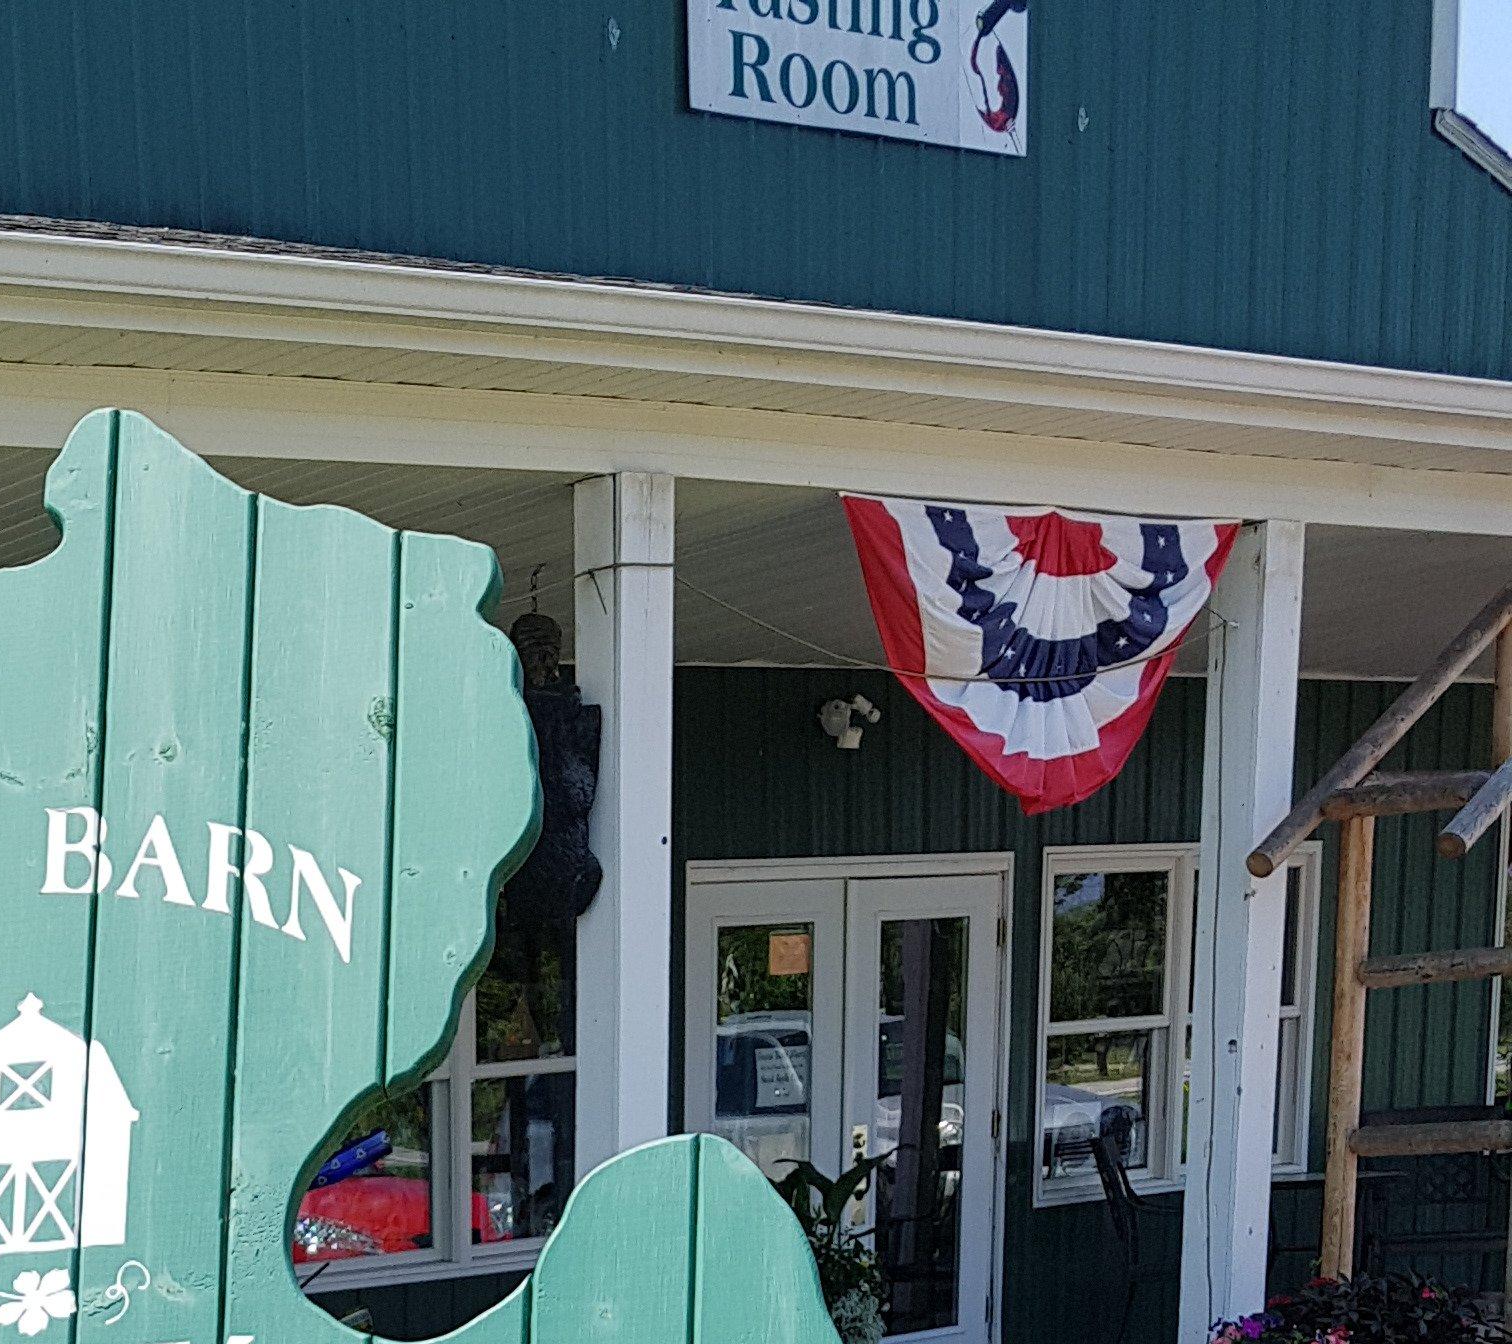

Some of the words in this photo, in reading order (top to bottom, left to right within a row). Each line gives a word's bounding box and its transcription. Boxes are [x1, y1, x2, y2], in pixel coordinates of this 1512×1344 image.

[716, 0, 942, 64] ting
[728, 28, 920, 126] Room
[40, 807, 362, 964] BARN
